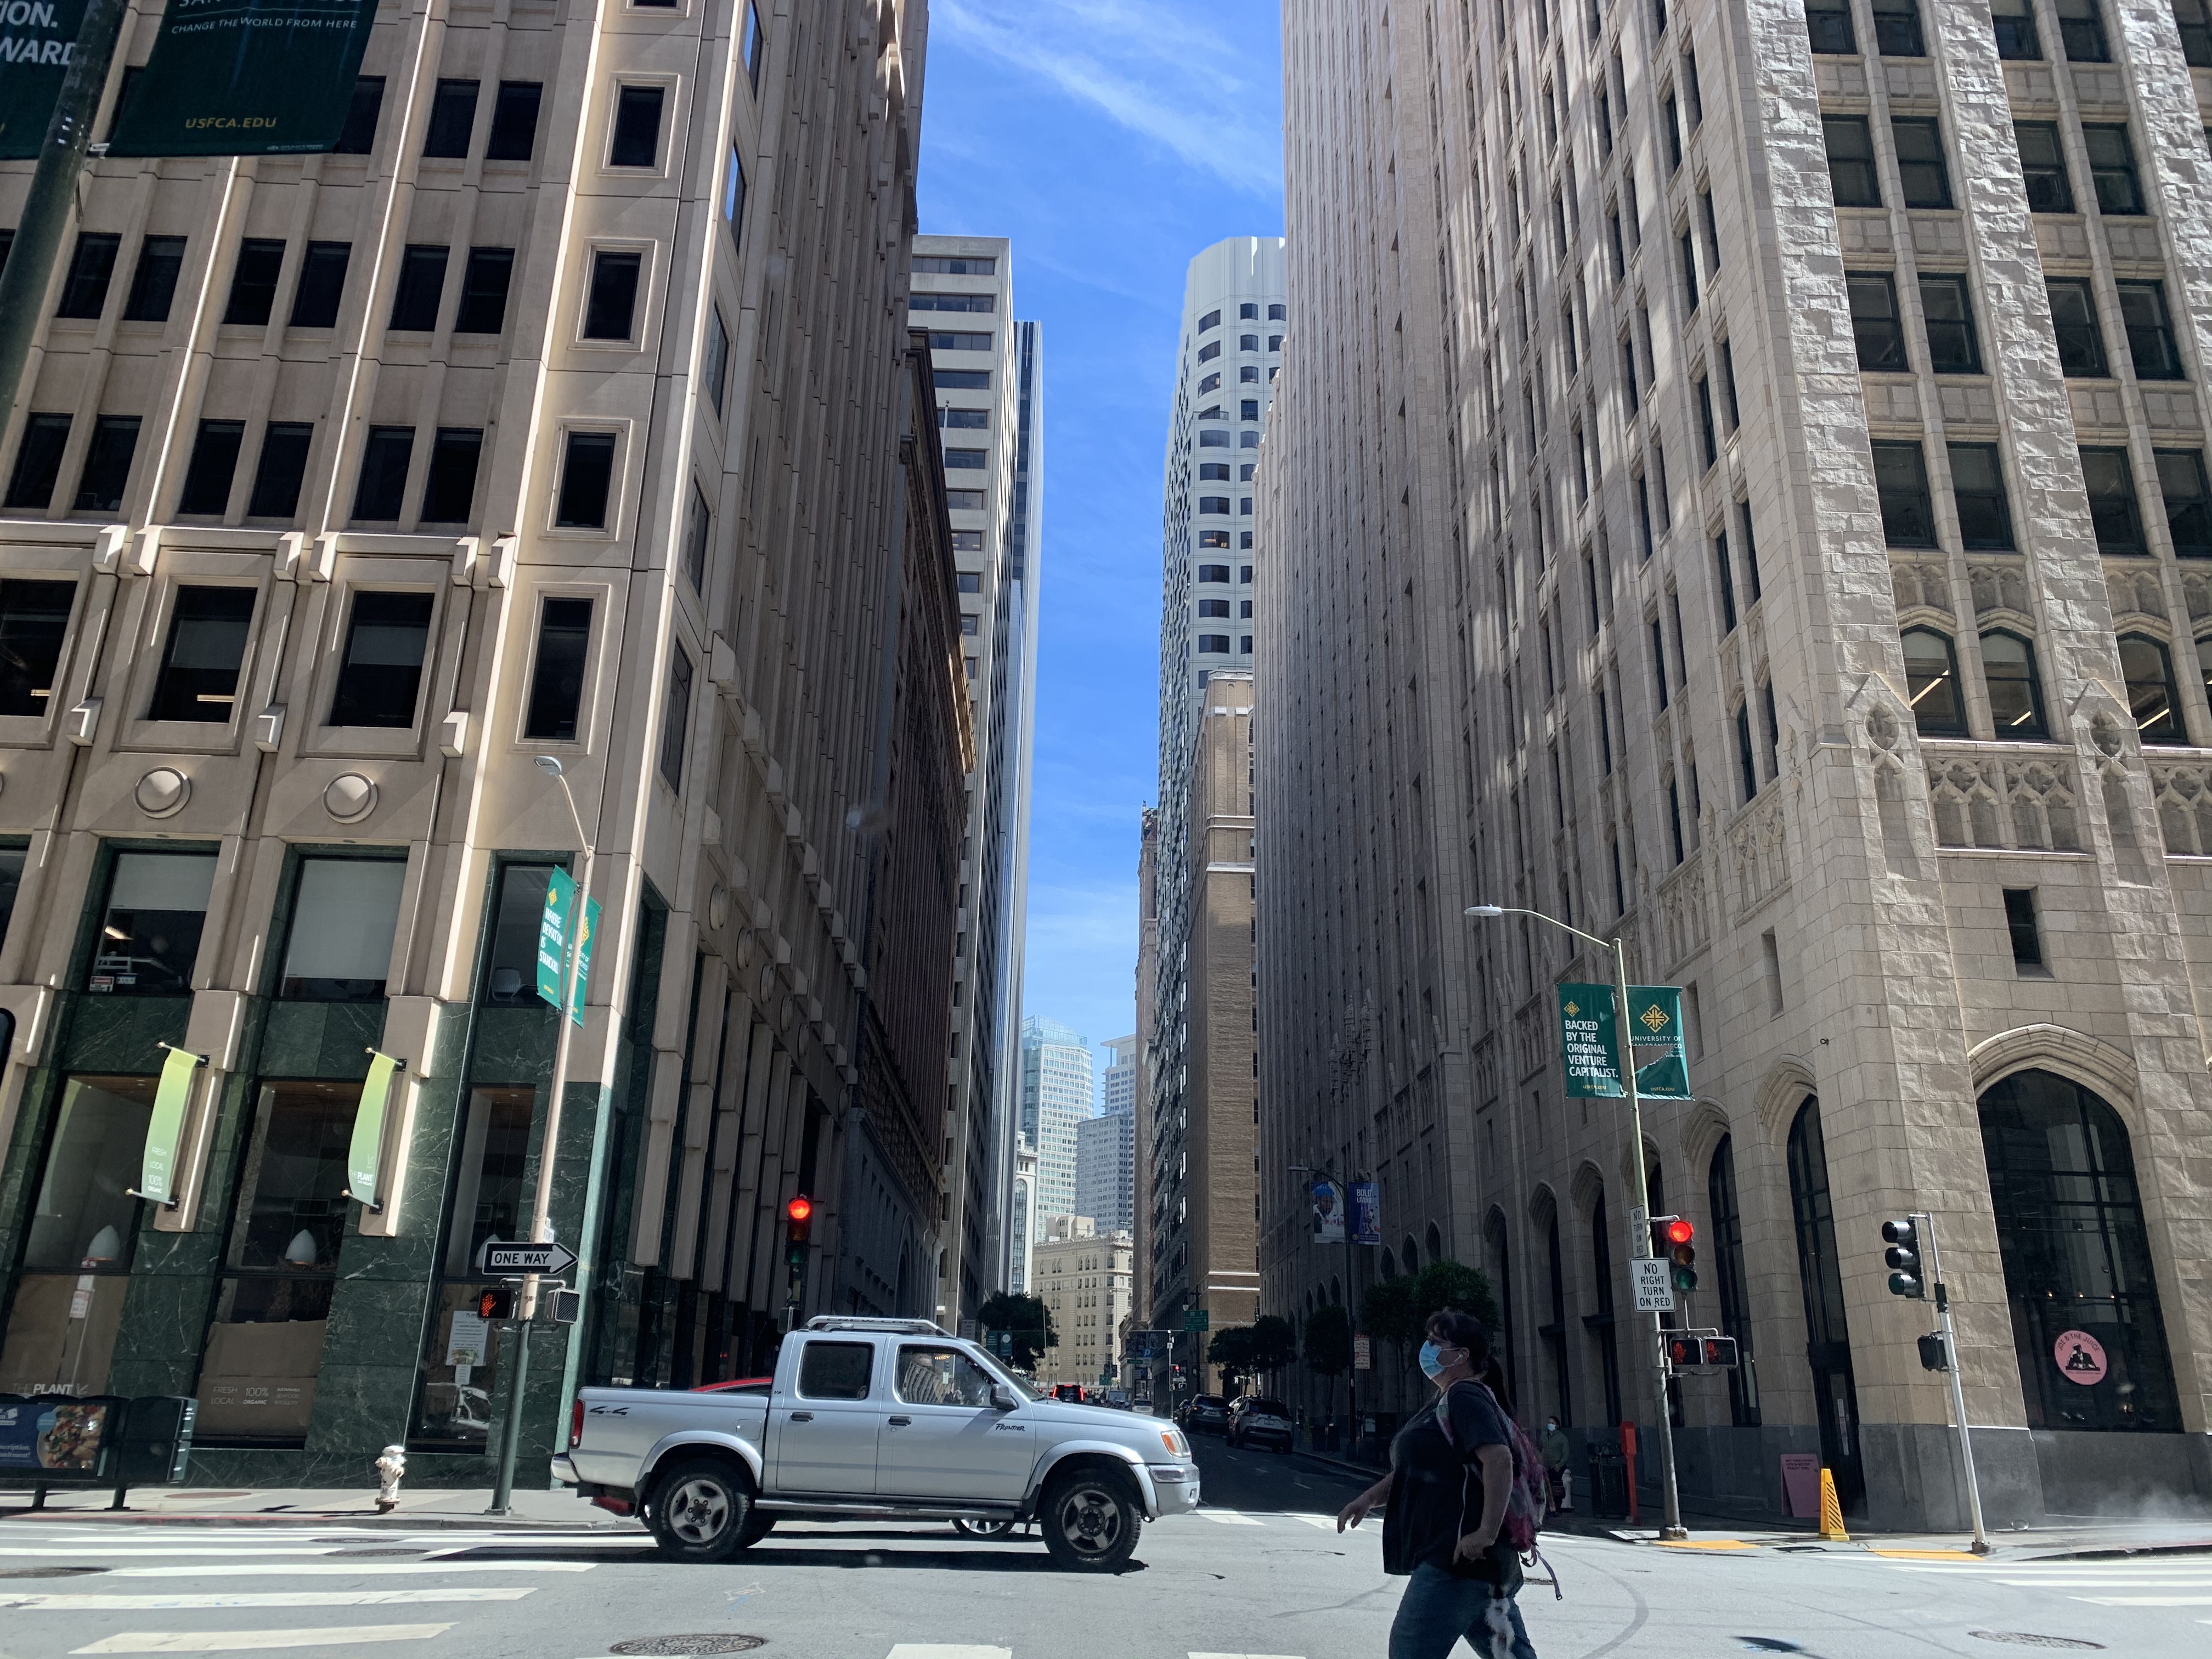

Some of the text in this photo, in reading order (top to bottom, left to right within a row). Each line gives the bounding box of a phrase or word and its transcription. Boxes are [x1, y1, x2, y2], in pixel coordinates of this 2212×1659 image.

[172, 17, 358, 34] CHANGE THE WORLD FROM HERE
[185, 117, 276, 129] USFCA.EDU
[545, 907, 562, 928] WHERE
[540, 935, 546, 949] IS
[1565, 1020, 1598, 1031] BACKED
[1566, 1031, 1597, 1042] BY THE
[1567, 1043, 1607, 1054] ORIGINAL
[1567, 1054, 1607, 1066] VENTURE
[1569, 1066, 1618, 1078] CAPITALIST.
[151, 1147, 166, 1157] FRESH
[149, 1160, 163, 1171] LOCAL
[148, 1175, 162, 1187] 100%
[357, 1171, 374, 1182] PLANT
[1356, 1188, 1372, 1197] BOLD
[1633, 1210, 1641, 1220] NO
[1633, 1223, 1643, 1232] TURN
[494, 1252, 550, 1265] ONE WAY
[1644, 1263, 1657, 1274] NO
[1640, 1276, 1664, 1285] RIGHT
[1643, 1286, 1664, 1295] TURN
[1640, 1297, 1671, 1306] ON RED
[2057, 1339, 2066, 1351] JOE
[2083, 1337, 2100, 1353] JUICE
[32, 1384, 74, 1395] PLANT
[245, 1387, 269, 1397] 100%
